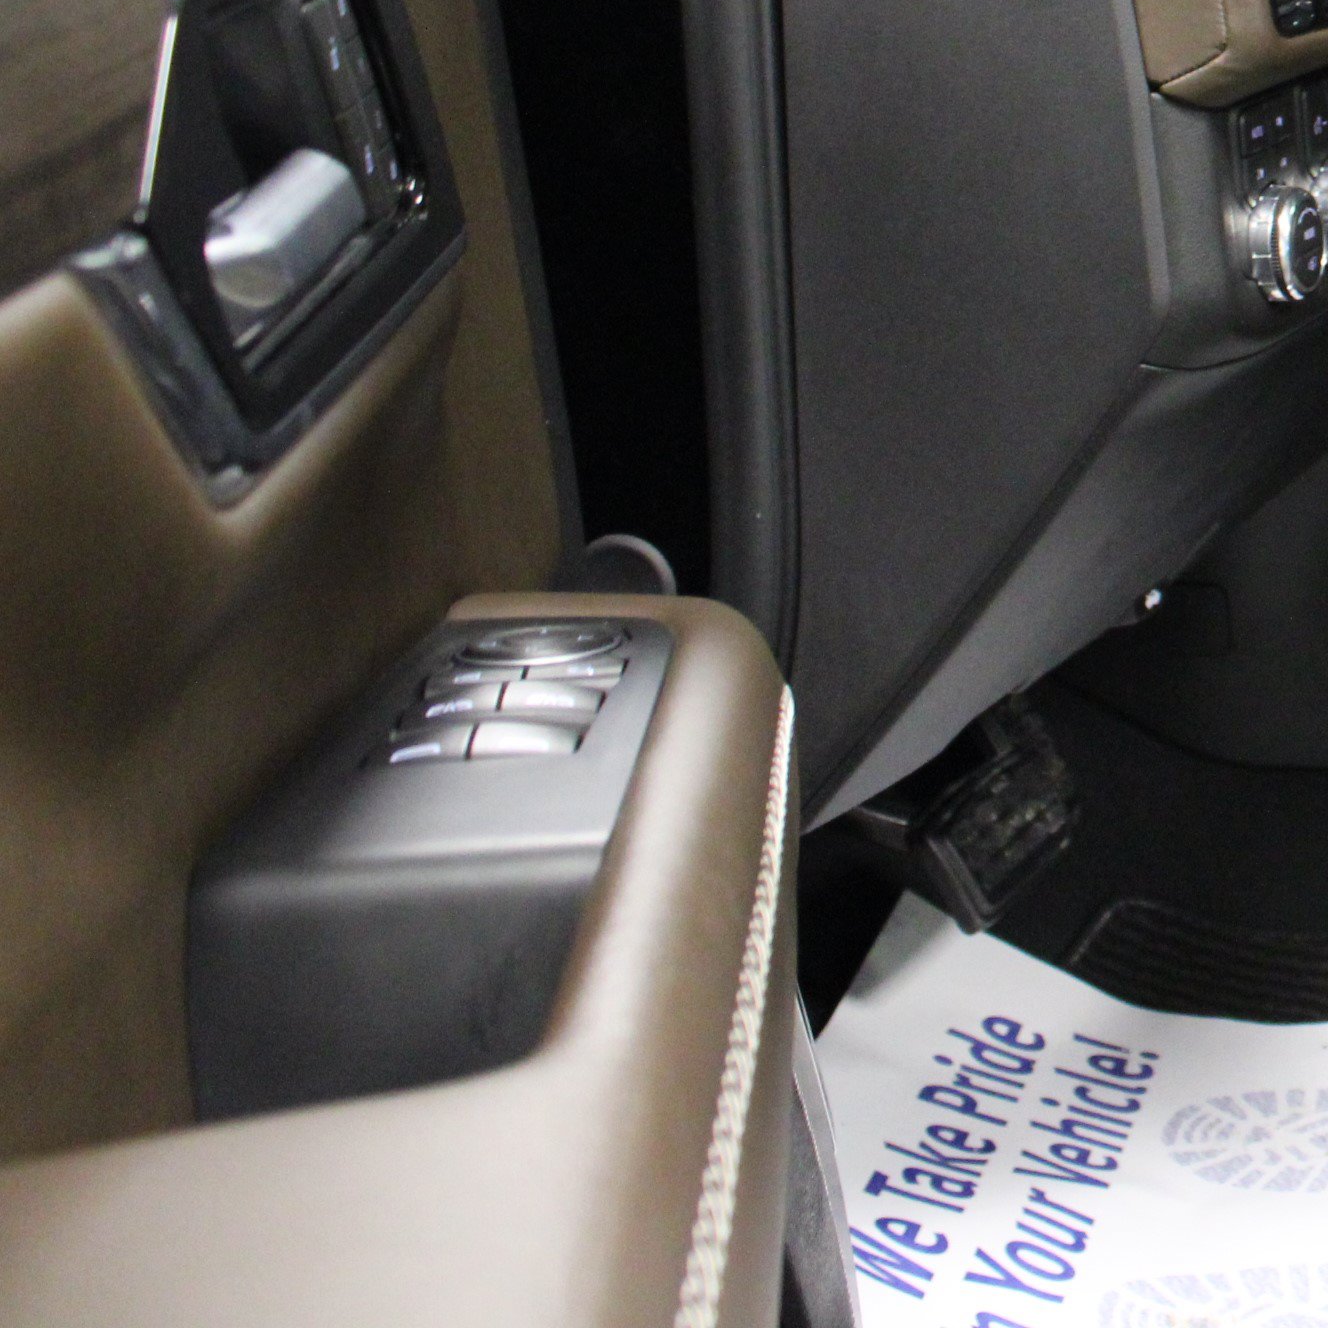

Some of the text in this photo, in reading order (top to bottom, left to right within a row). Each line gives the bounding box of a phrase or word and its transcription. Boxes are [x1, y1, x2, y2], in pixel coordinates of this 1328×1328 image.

[849, 1015, 1046, 1300] We Take Pride
[1012, 1033, 1161, 1189] Vehicle!
[963, 1186, 1094, 1304] Your
